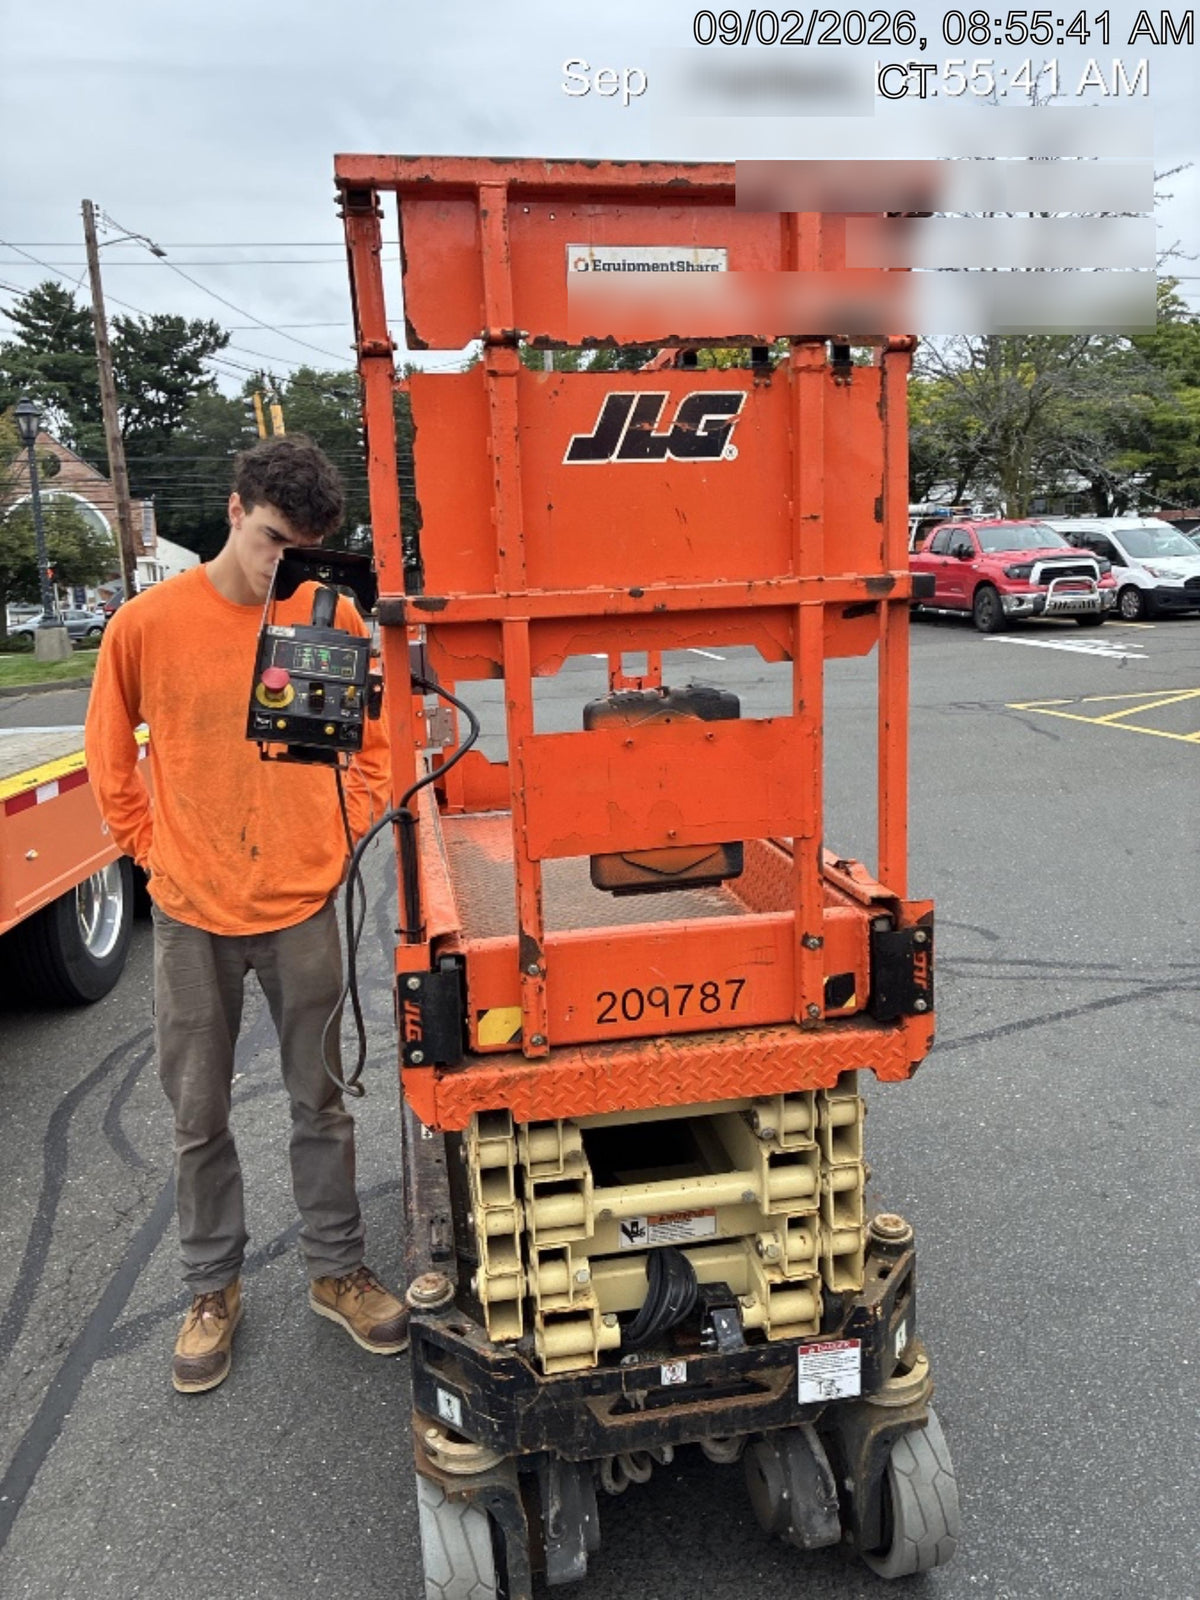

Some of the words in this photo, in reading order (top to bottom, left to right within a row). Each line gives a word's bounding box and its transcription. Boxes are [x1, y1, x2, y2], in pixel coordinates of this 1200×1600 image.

[562, 390, 747, 464] JLG
[403, 1000, 423, 1042] JLG
[597, 979, 746, 1024] 209787
